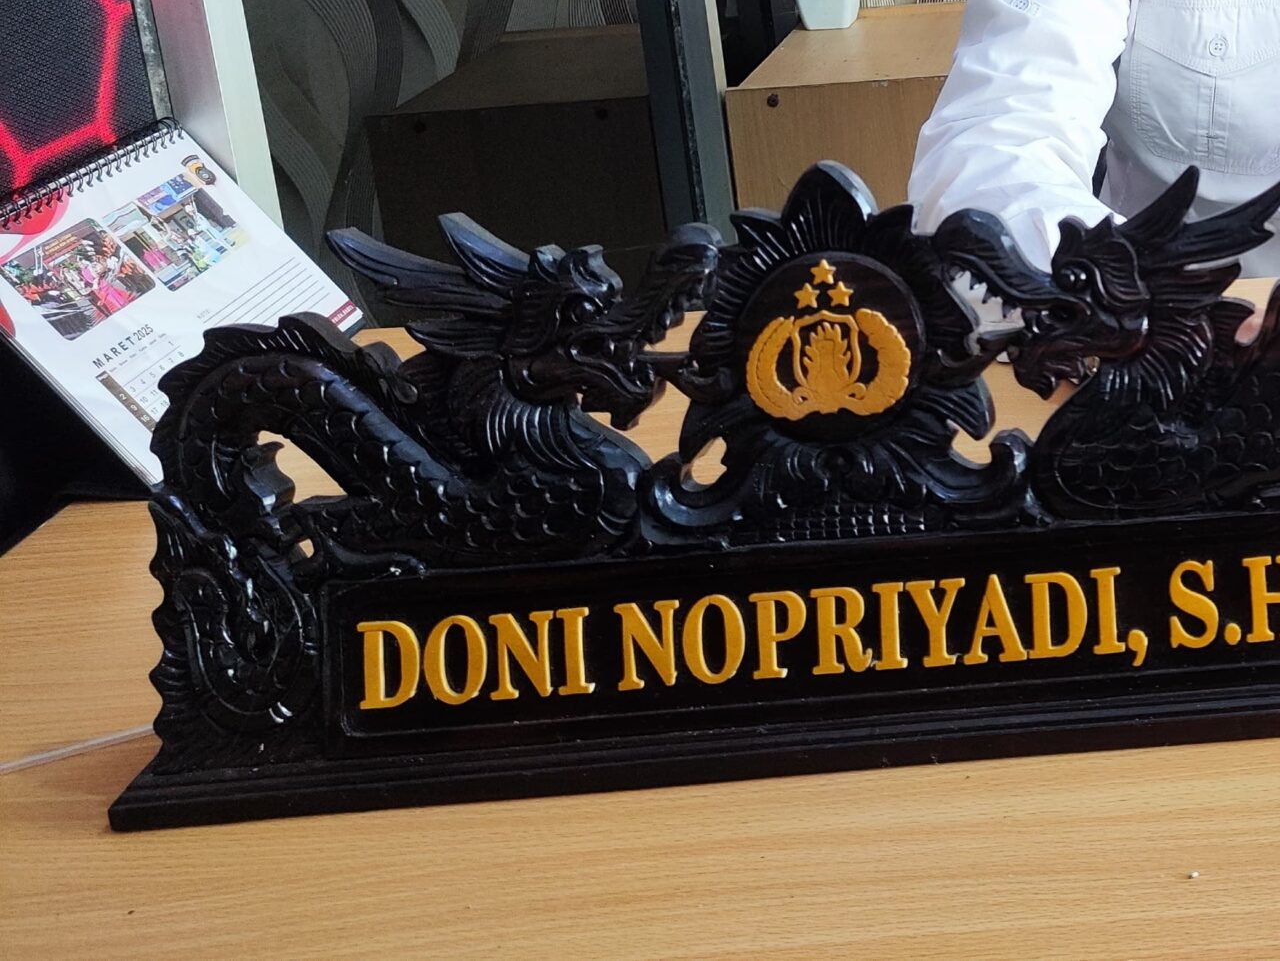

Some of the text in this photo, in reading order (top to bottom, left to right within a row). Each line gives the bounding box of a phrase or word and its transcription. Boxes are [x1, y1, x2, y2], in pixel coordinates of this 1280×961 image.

[92, 324, 154, 369] MARET 2025
[140, 396, 149, 404] 10
[150, 389, 159, 397] 11
[357, 607, 595, 710] DONI
[613, 567, 1148, 691] NOPRIYADI,
